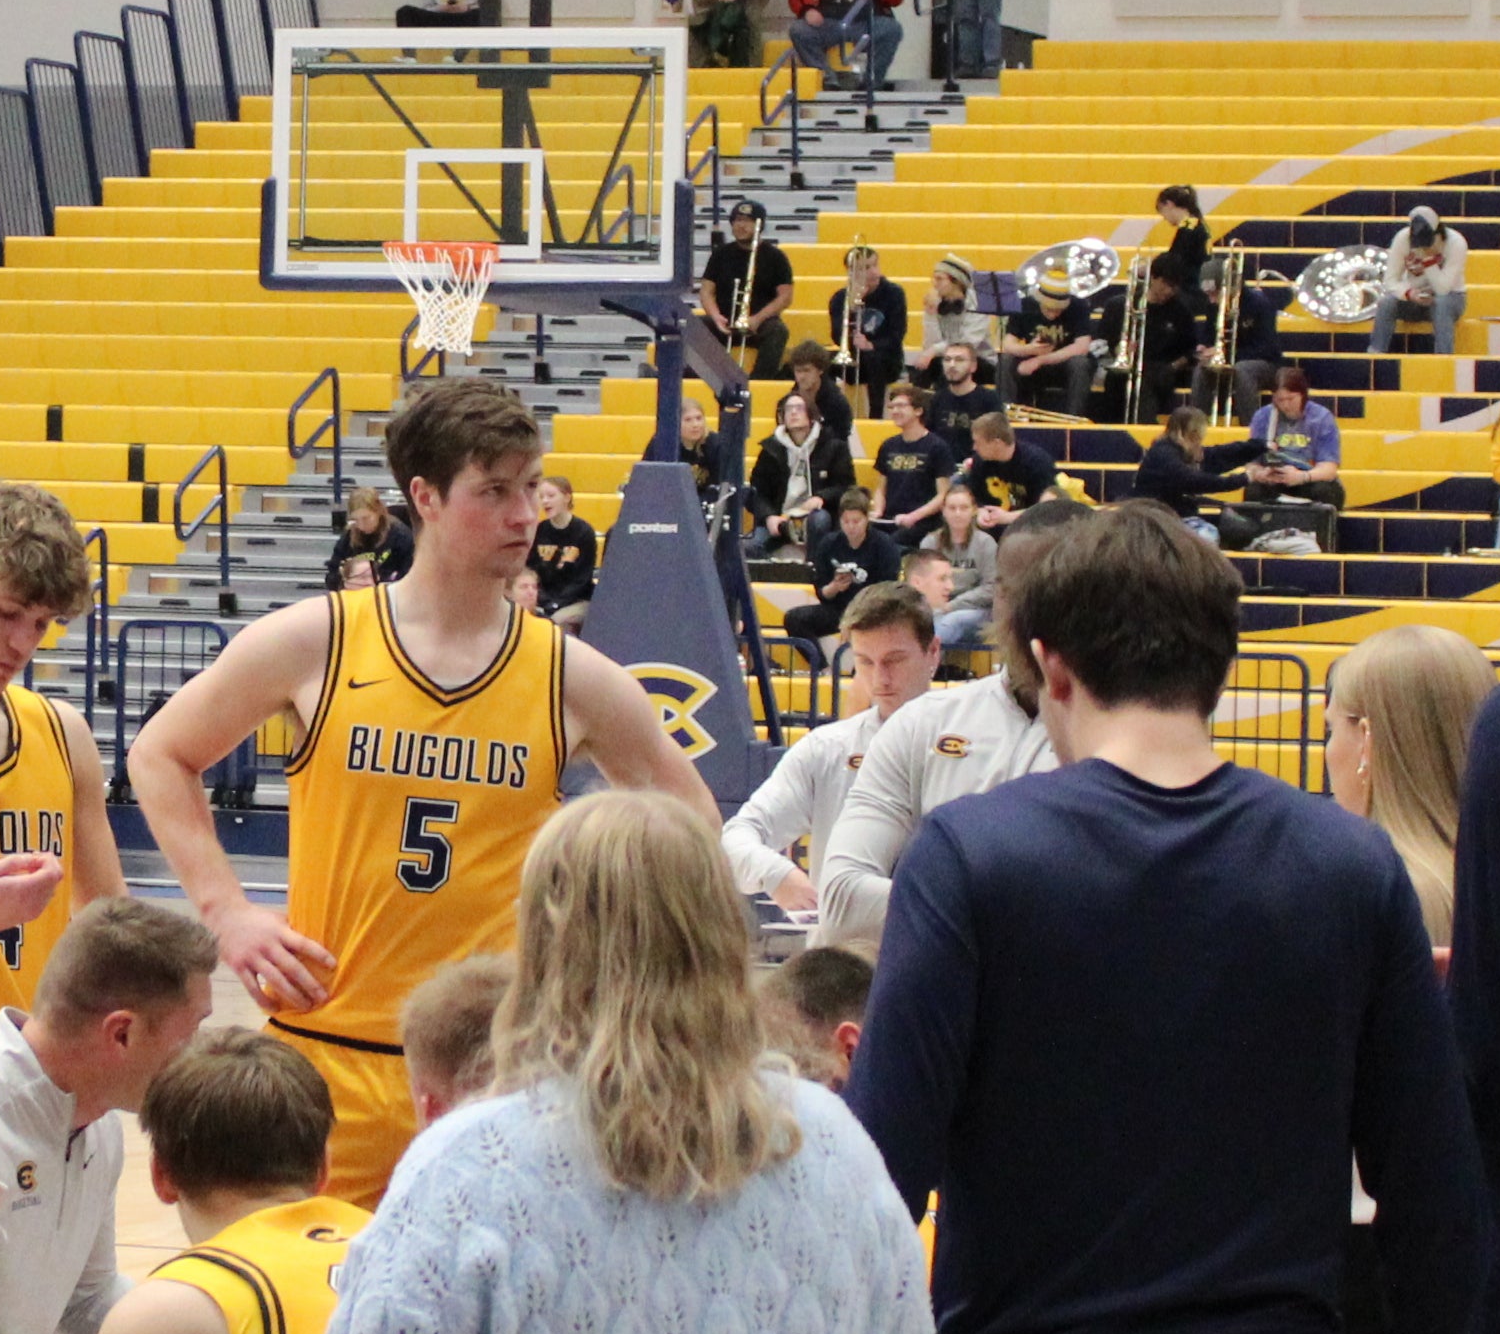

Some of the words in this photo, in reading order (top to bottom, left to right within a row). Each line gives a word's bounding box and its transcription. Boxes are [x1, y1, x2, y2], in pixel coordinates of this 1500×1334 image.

[629, 522, 678, 534] porter
[346, 725, 529, 790] BLUGOLDS
[395, 795, 460, 894] 5
